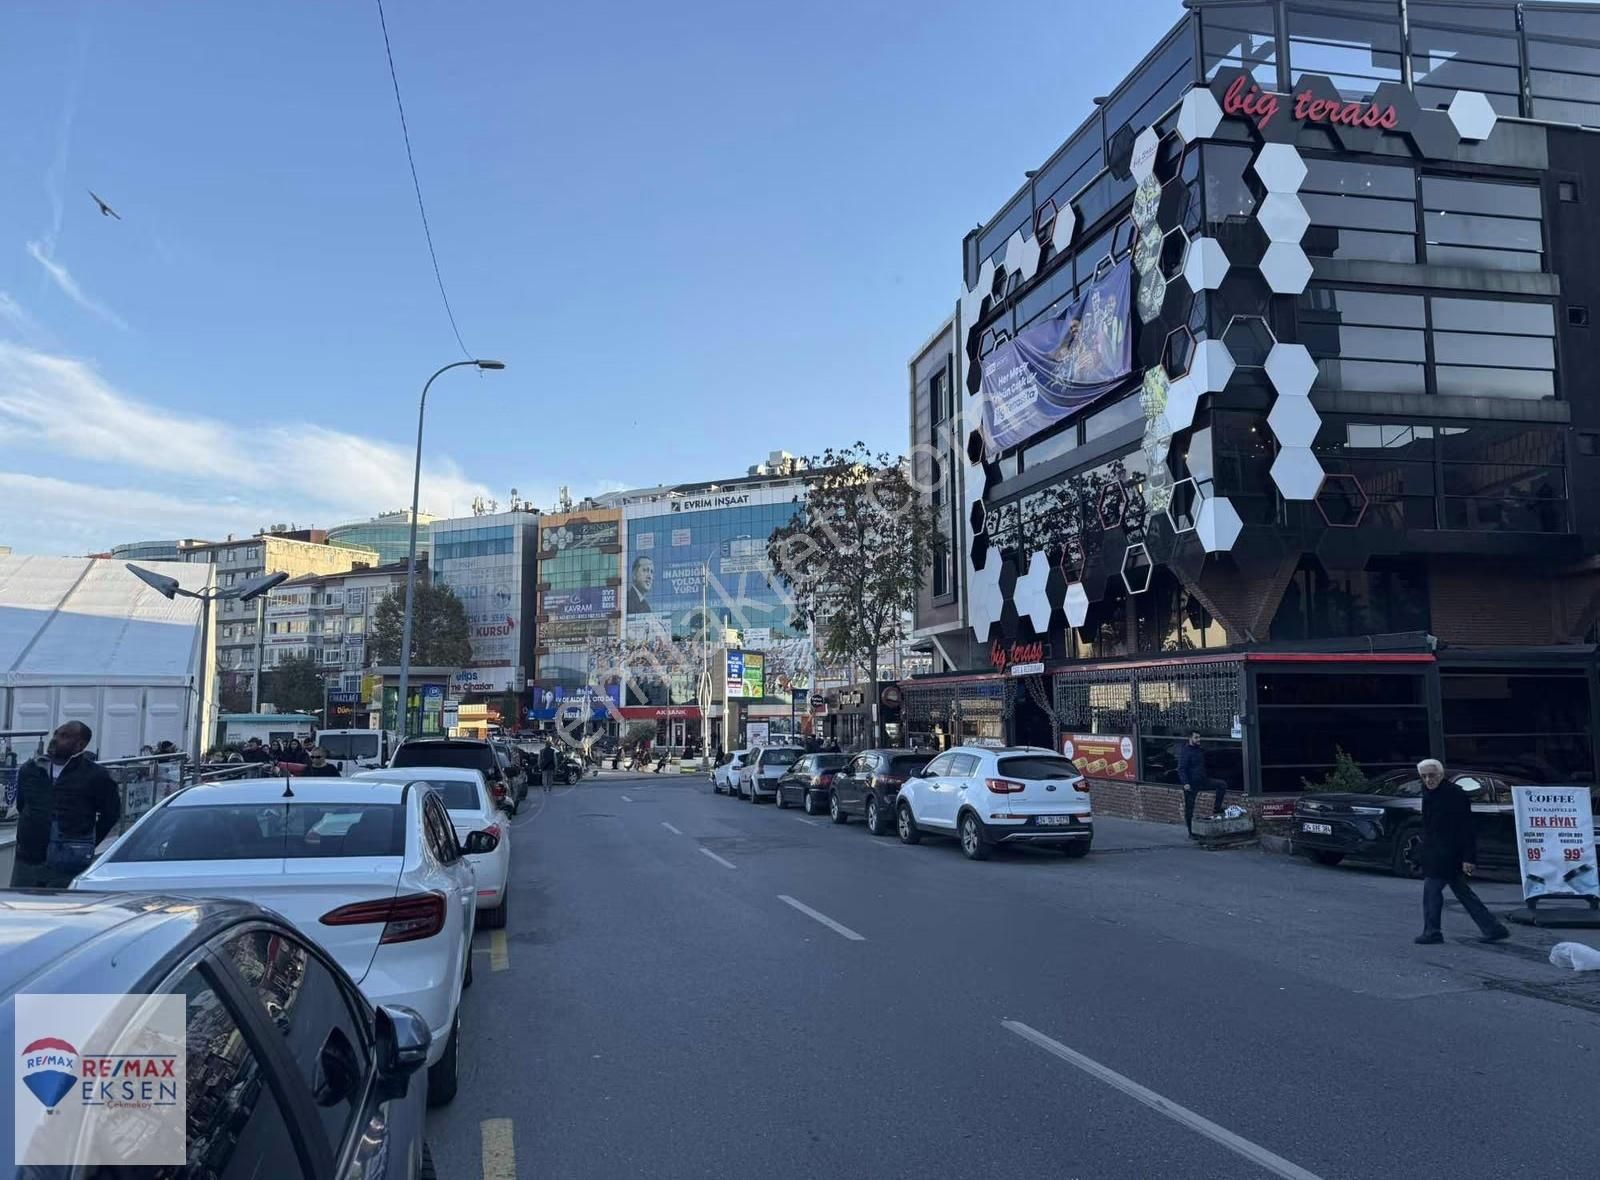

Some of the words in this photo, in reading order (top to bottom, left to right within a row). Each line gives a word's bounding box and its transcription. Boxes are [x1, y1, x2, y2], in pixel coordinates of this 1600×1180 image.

[1223, 75, 1280, 130] big
[1293, 89, 1399, 129] terass
[684, 499, 712, 511] EVRİM
[714, 495, 749, 507] İNŞAAT
[564, 603, 593, 613] KAVRAM
[1528, 794, 1576, 803] COFFEE
[1529, 816, 1548, 827] TEK
[1549, 815, 1577, 827] FİYAT
